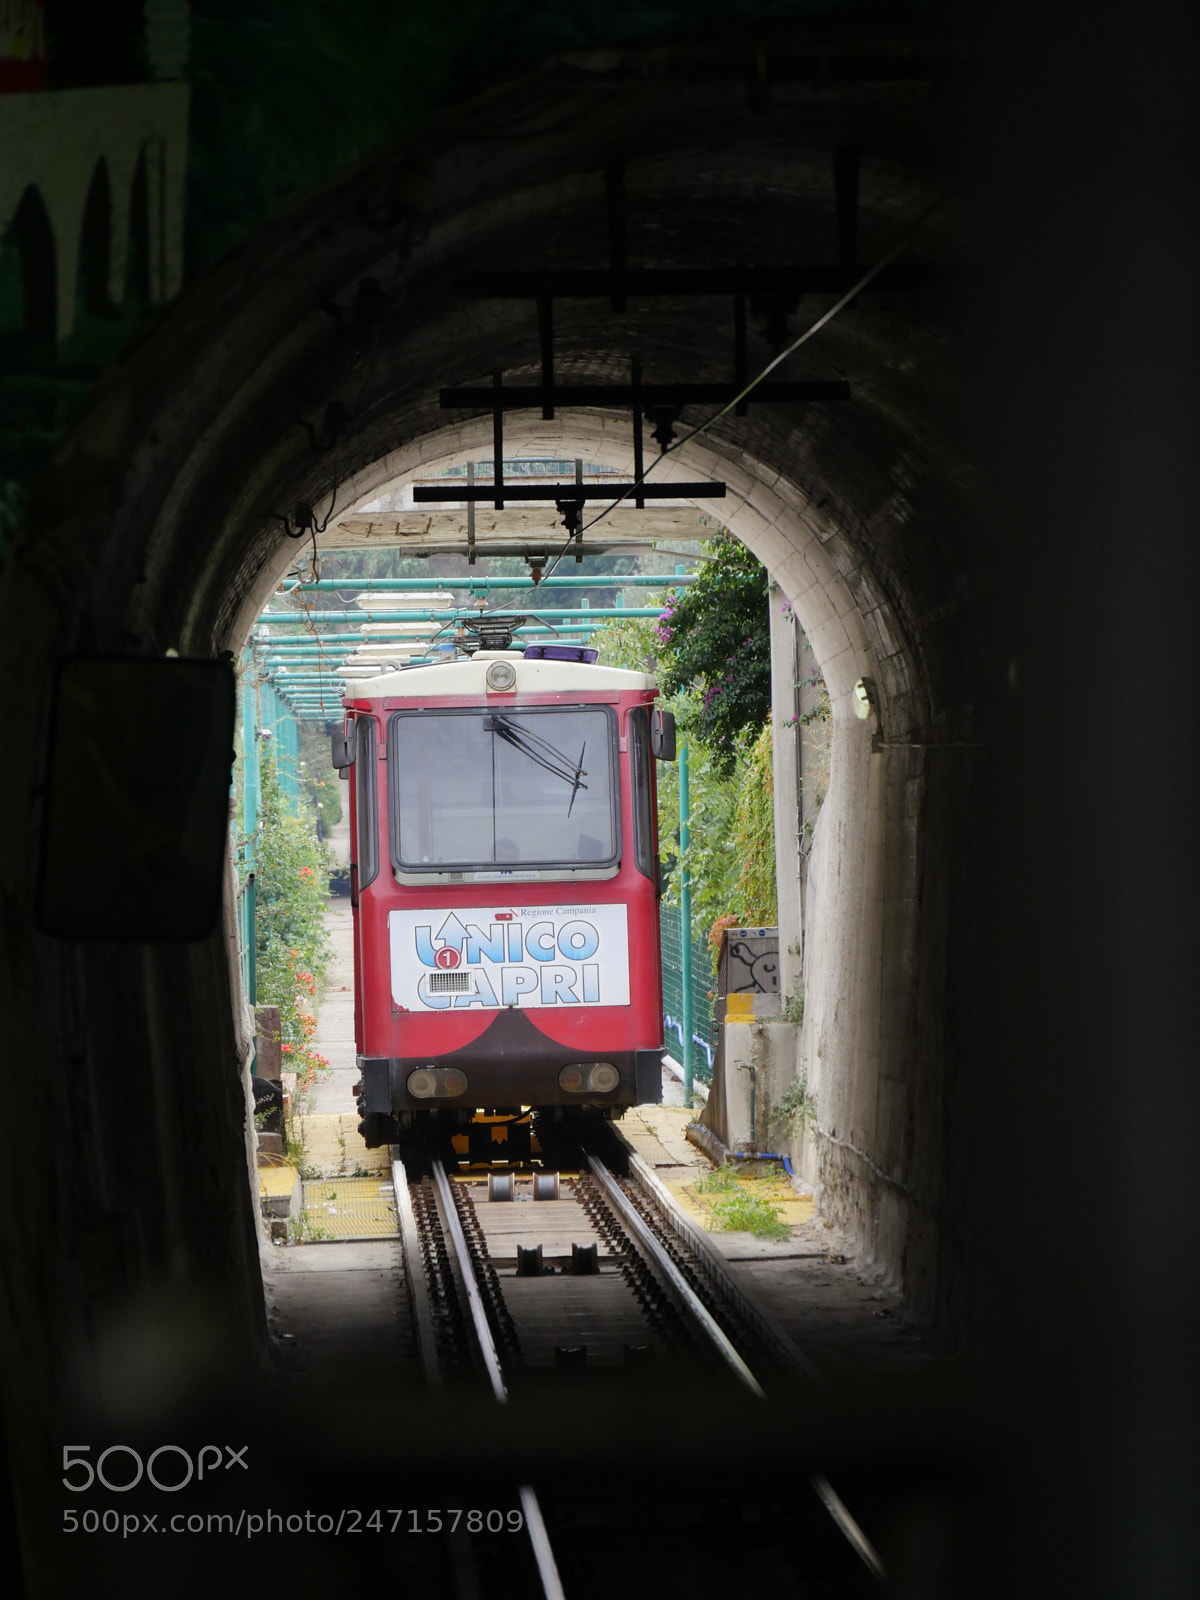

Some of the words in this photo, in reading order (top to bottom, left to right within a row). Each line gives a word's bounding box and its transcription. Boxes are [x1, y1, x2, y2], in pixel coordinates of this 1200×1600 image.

[520, 908, 554, 918] Regione
[556, 906, 596, 916] Campania
[415, 911, 600, 967] UNICO
